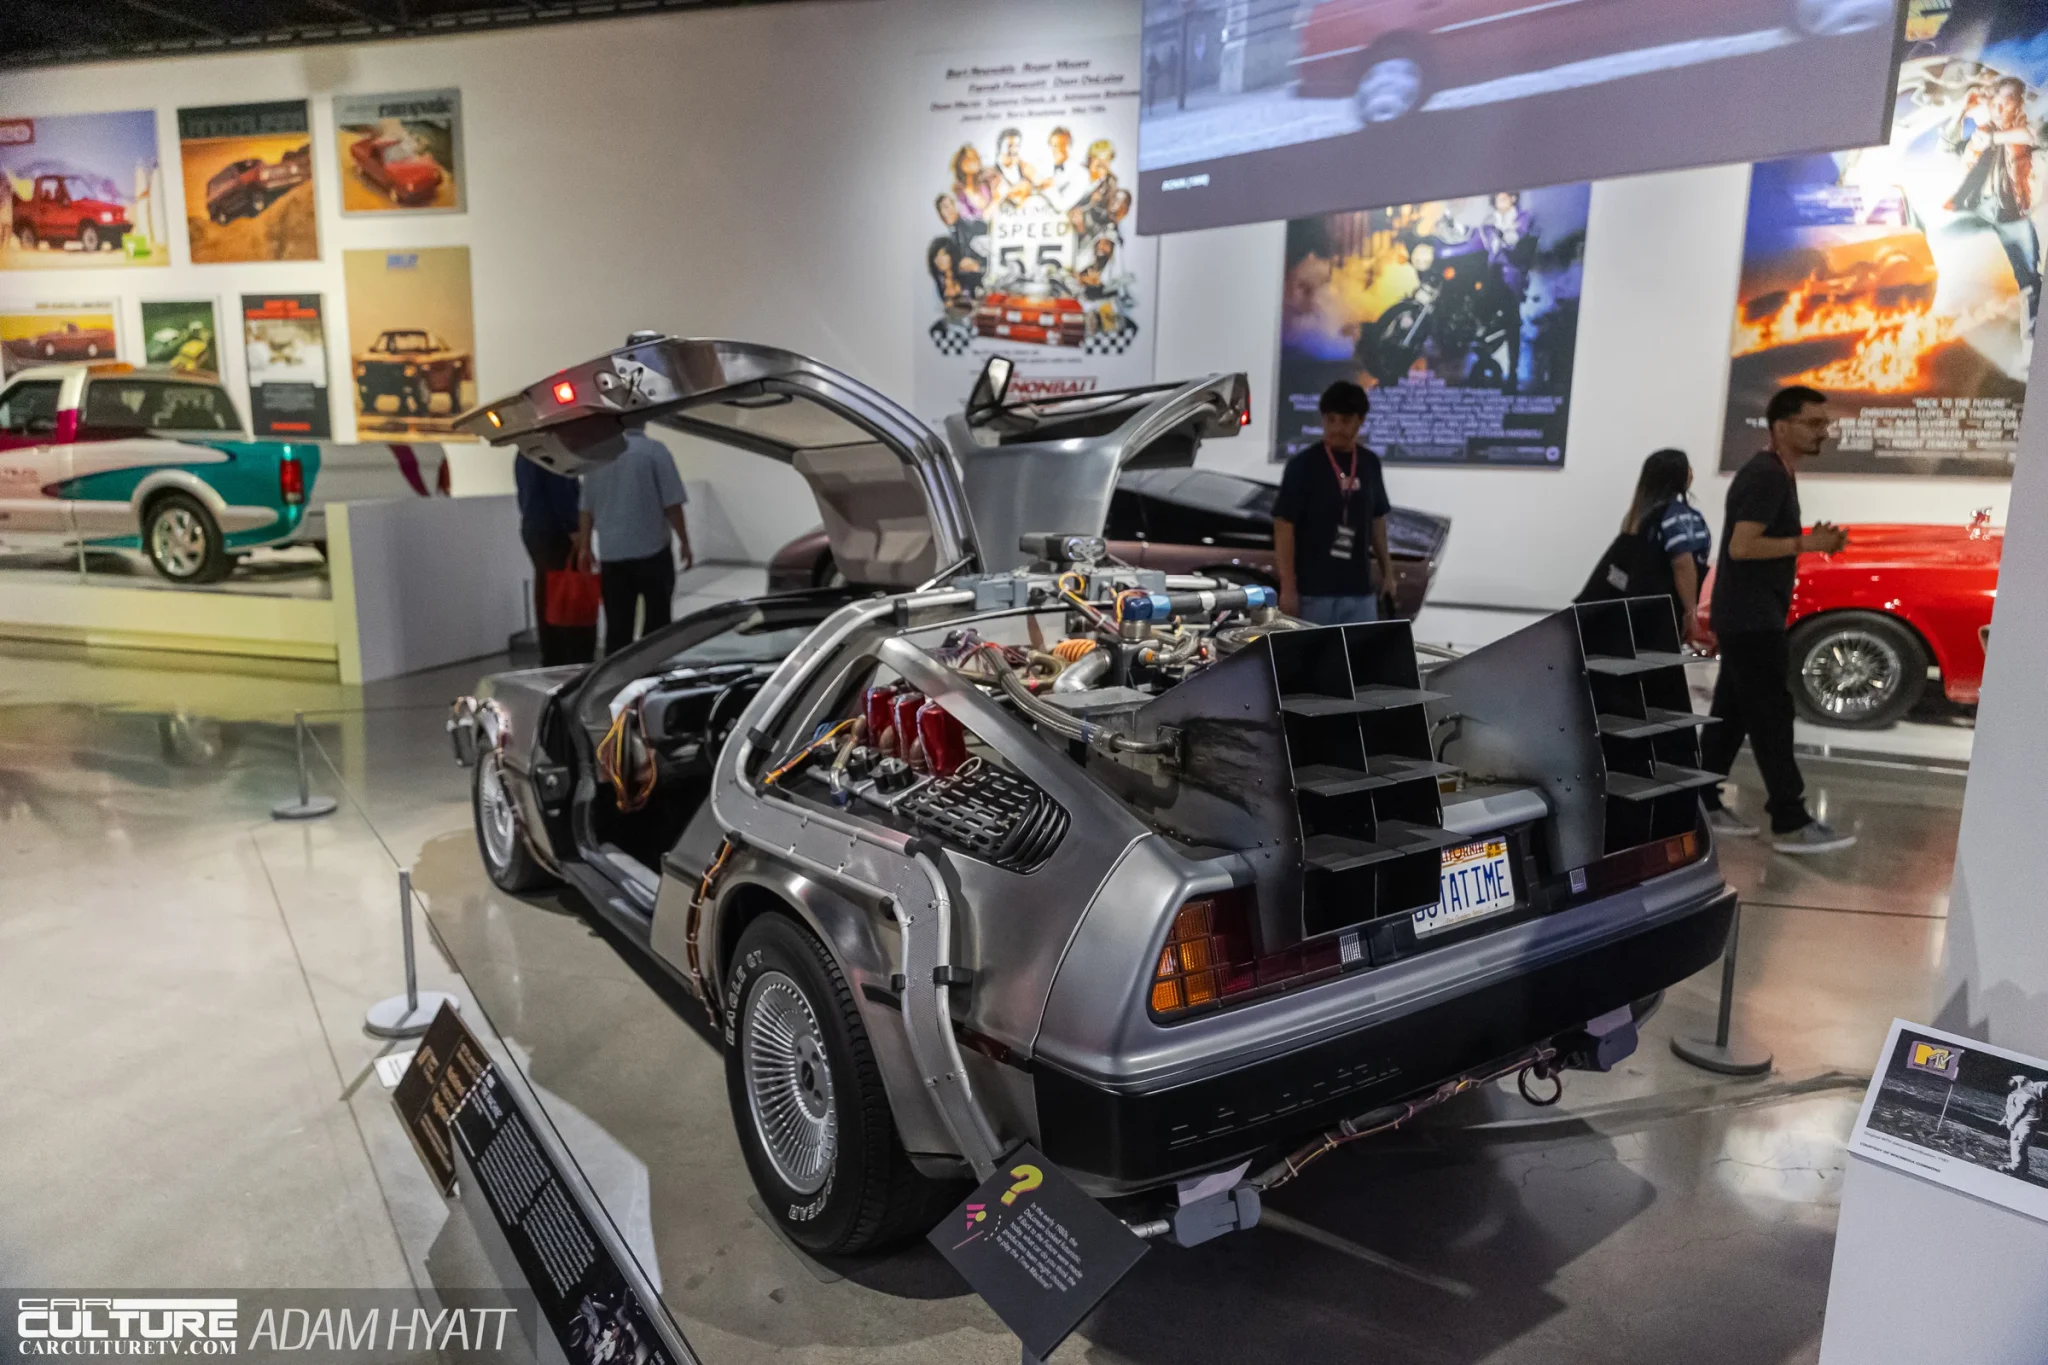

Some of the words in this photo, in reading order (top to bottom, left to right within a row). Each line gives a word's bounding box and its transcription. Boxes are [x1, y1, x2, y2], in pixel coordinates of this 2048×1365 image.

[998, 221, 1069, 239] SPEED
[1414, 859, 1510, 922] TATIME
[725, 965, 747, 1046] EAGLE
[746, 949, 762, 968] GT
[1914, 1043, 1955, 1070] MTV
[1002, 1229, 1027, 1252] production
[1020, 1218, 1032, 1230] Back
[1035, 1233, 1044, 1242] the
[1043, 1239, 1058, 1255] Future
[1024, 1209, 1045, 1230] DeLorean
[1044, 1227, 1062, 1245] looked
[1036, 1207, 1044, 1216] the
[1043, 1215, 1055, 1226] early
[1069, 1237, 1078, 1247] the
[1010, 1249, 1019, 1258] the
[1023, 1235, 1035, 1247] what
[1067, 1276, 1076, 1286] the
